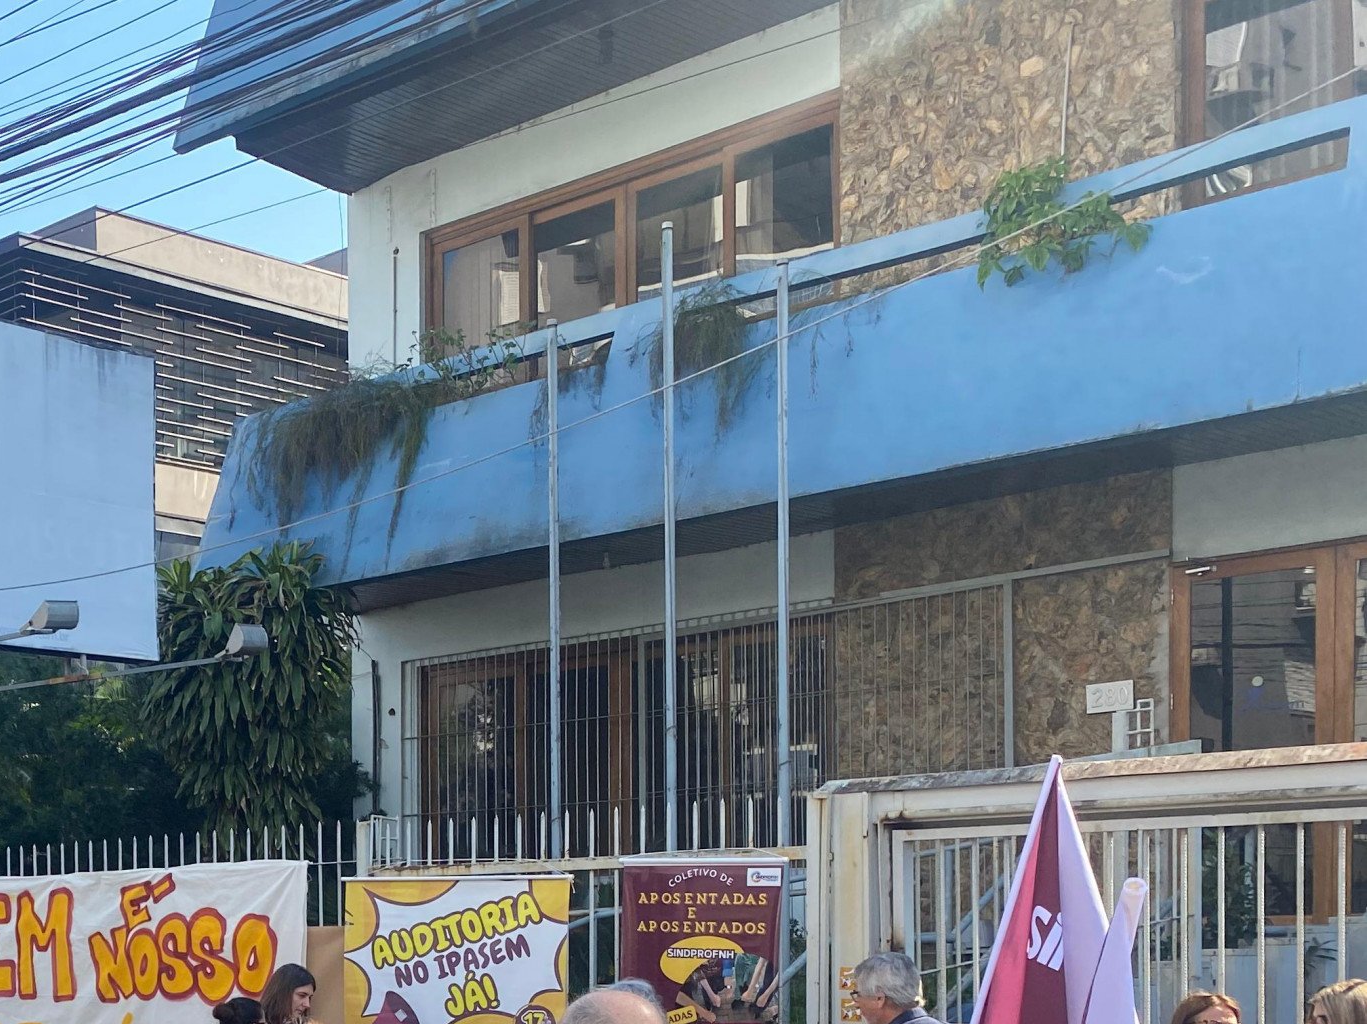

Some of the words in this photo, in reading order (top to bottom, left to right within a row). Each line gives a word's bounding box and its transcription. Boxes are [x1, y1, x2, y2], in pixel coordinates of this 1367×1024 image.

[1090, 687, 1128, 708] 280
[668, 868, 717, 887] COLETIVO
[720, 873, 734, 887] DE
[638, 893, 767, 905] APOSENTADAS
[688, 907, 697, 919] E
[372, 891, 543, 970] AUDITORIA
[637, 921, 766, 934] APOSENTADOS
[89, 907, 278, 1006] NOSSO
[395, 960, 429, 988] NO
[434, 934, 531, 979] IPASEM
[445, 970, 500, 1018] JÁ!
